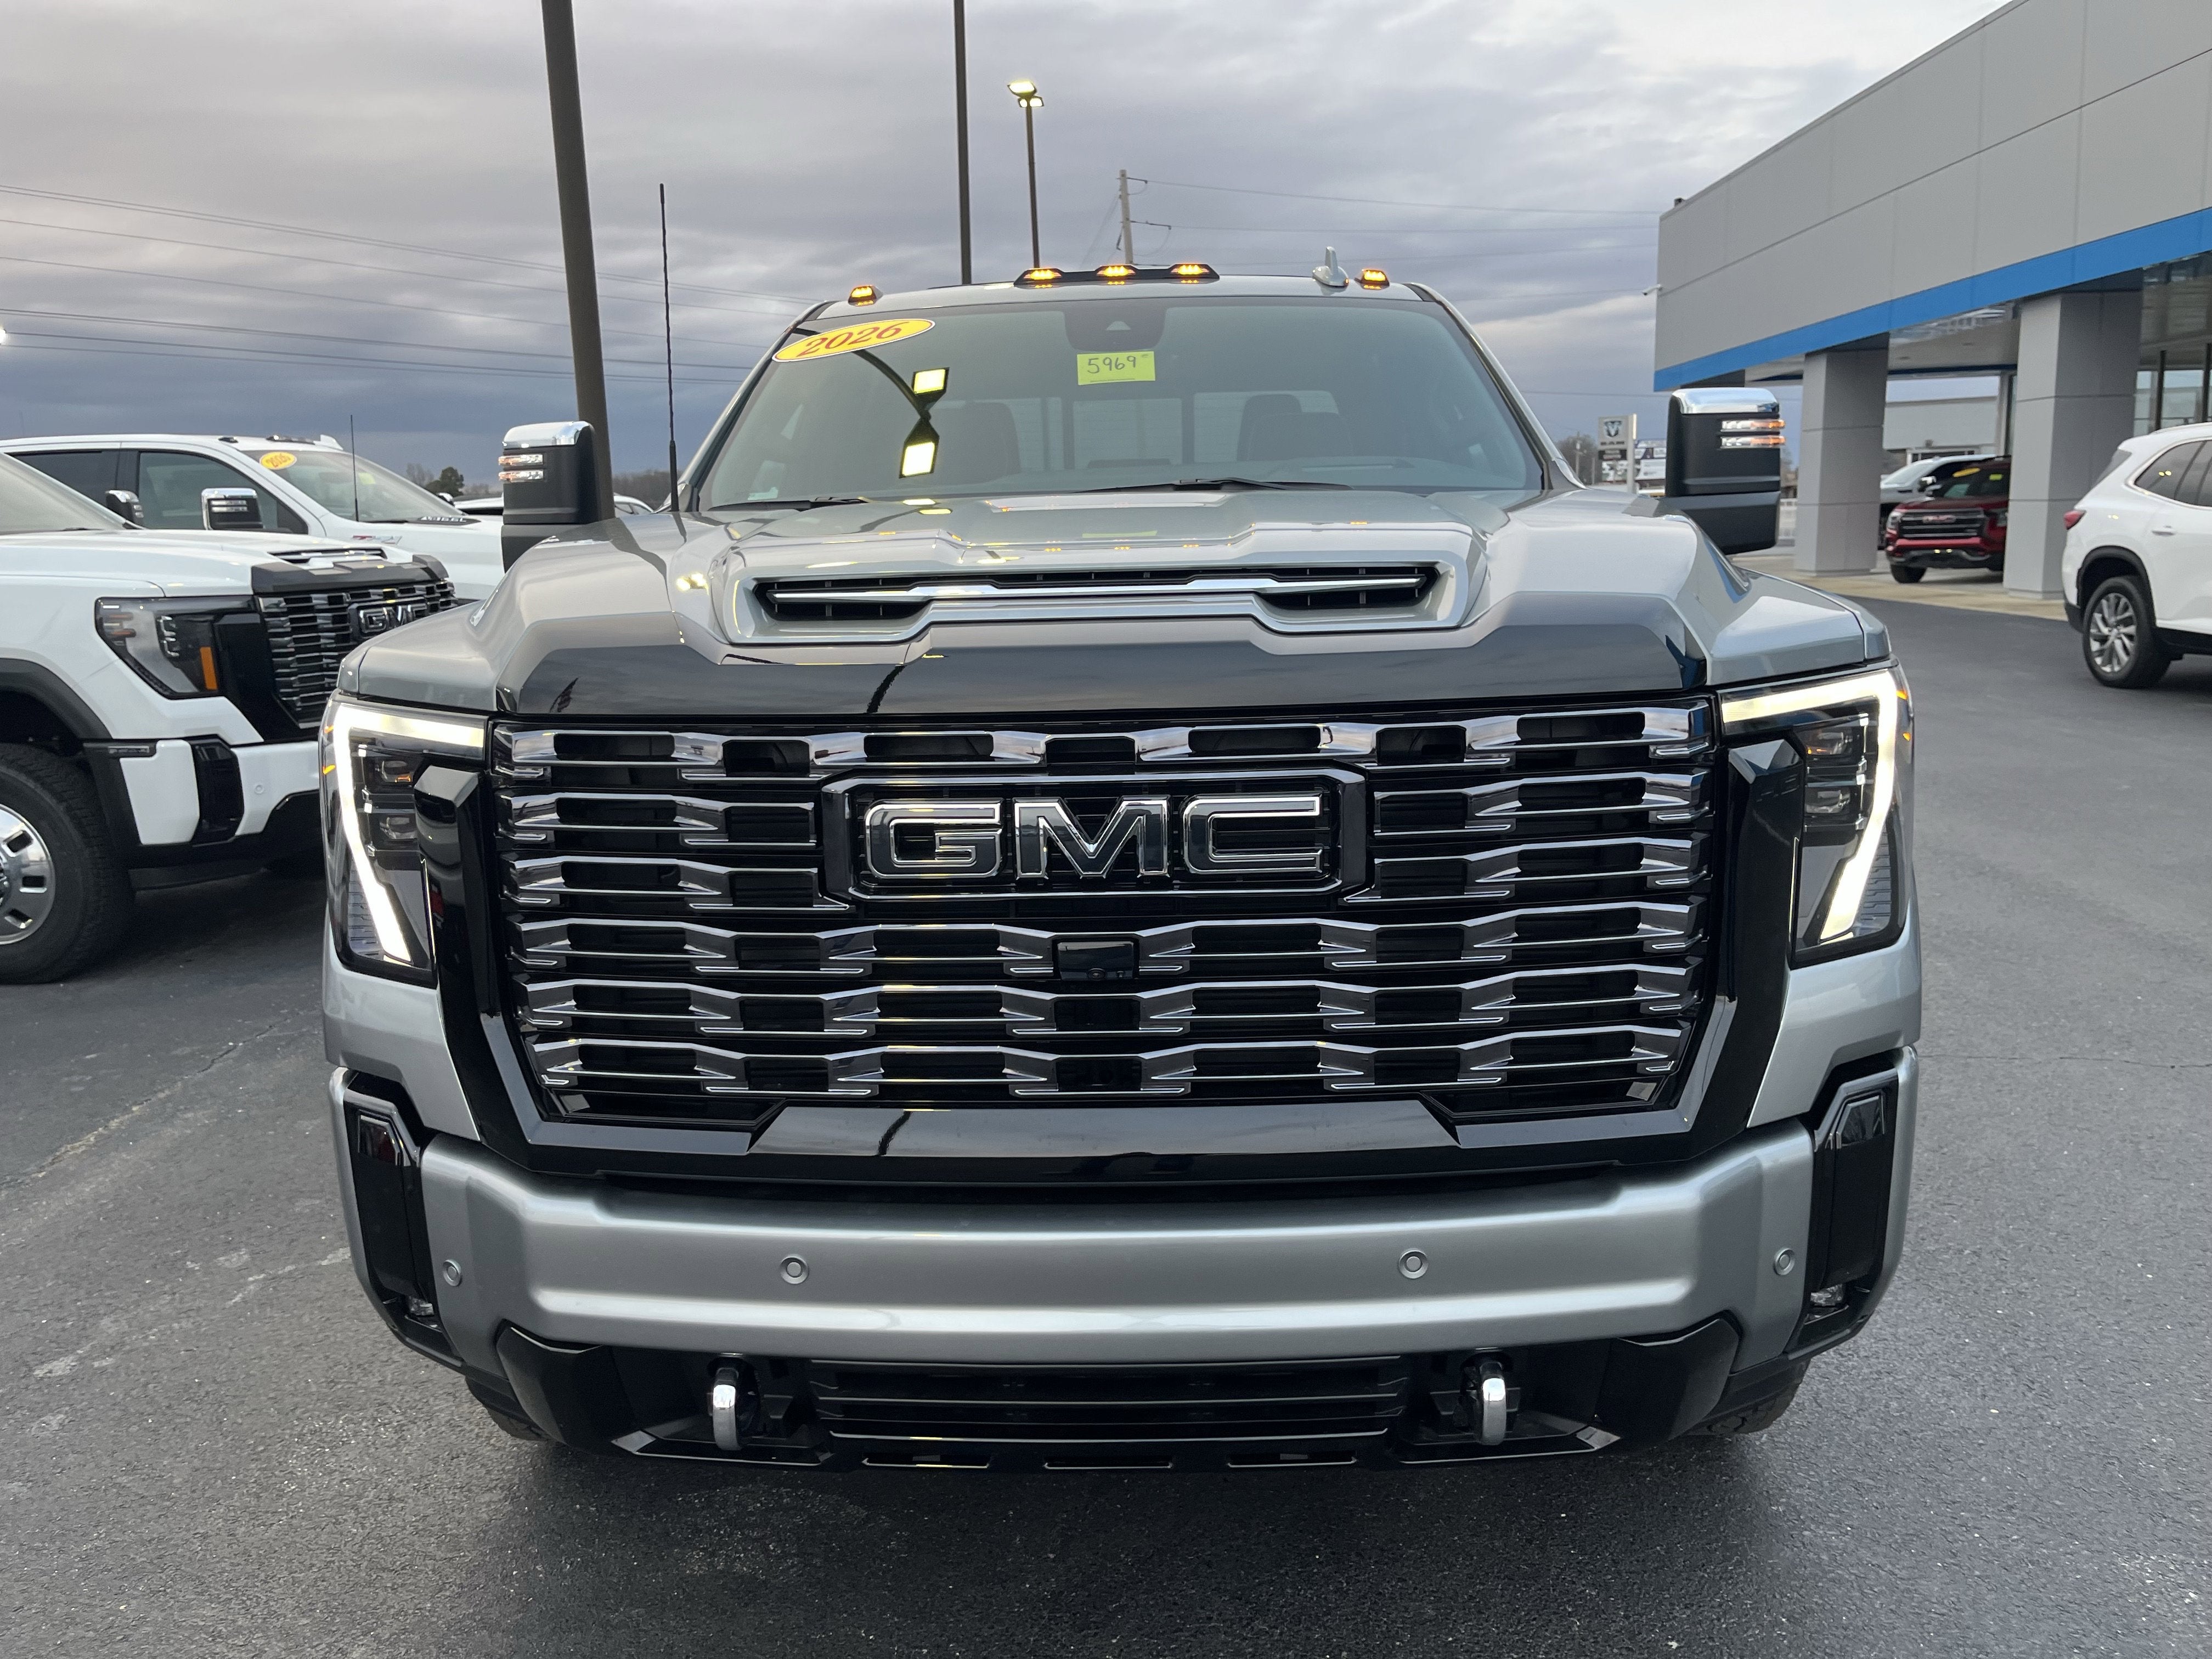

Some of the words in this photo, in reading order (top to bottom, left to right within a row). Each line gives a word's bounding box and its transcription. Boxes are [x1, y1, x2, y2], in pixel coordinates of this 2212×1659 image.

[795, 321, 910, 358] 2026
[1087, 355, 1136, 374] 5969
[863, 794, 1323, 879] GMC
